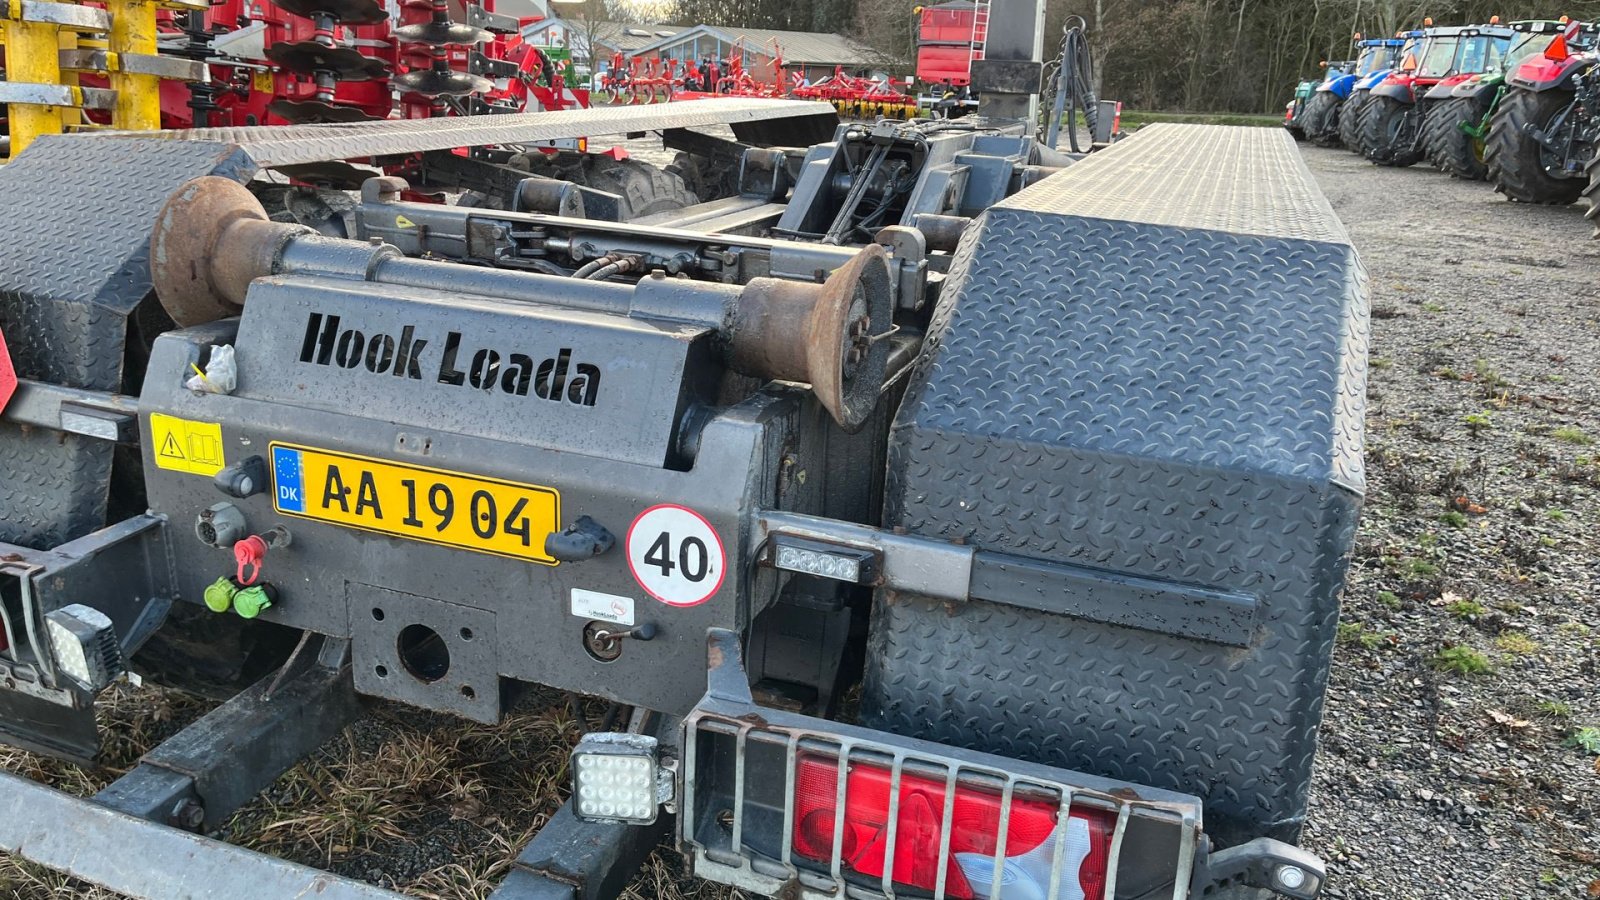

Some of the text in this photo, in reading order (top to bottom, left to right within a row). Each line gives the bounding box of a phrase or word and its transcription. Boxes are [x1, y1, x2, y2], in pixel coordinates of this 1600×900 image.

[300, 312, 601, 407] Hook Loada
[280, 485, 298, 501] DK
[322, 464, 383, 520] AA
[643, 531, 708, 583] 40
